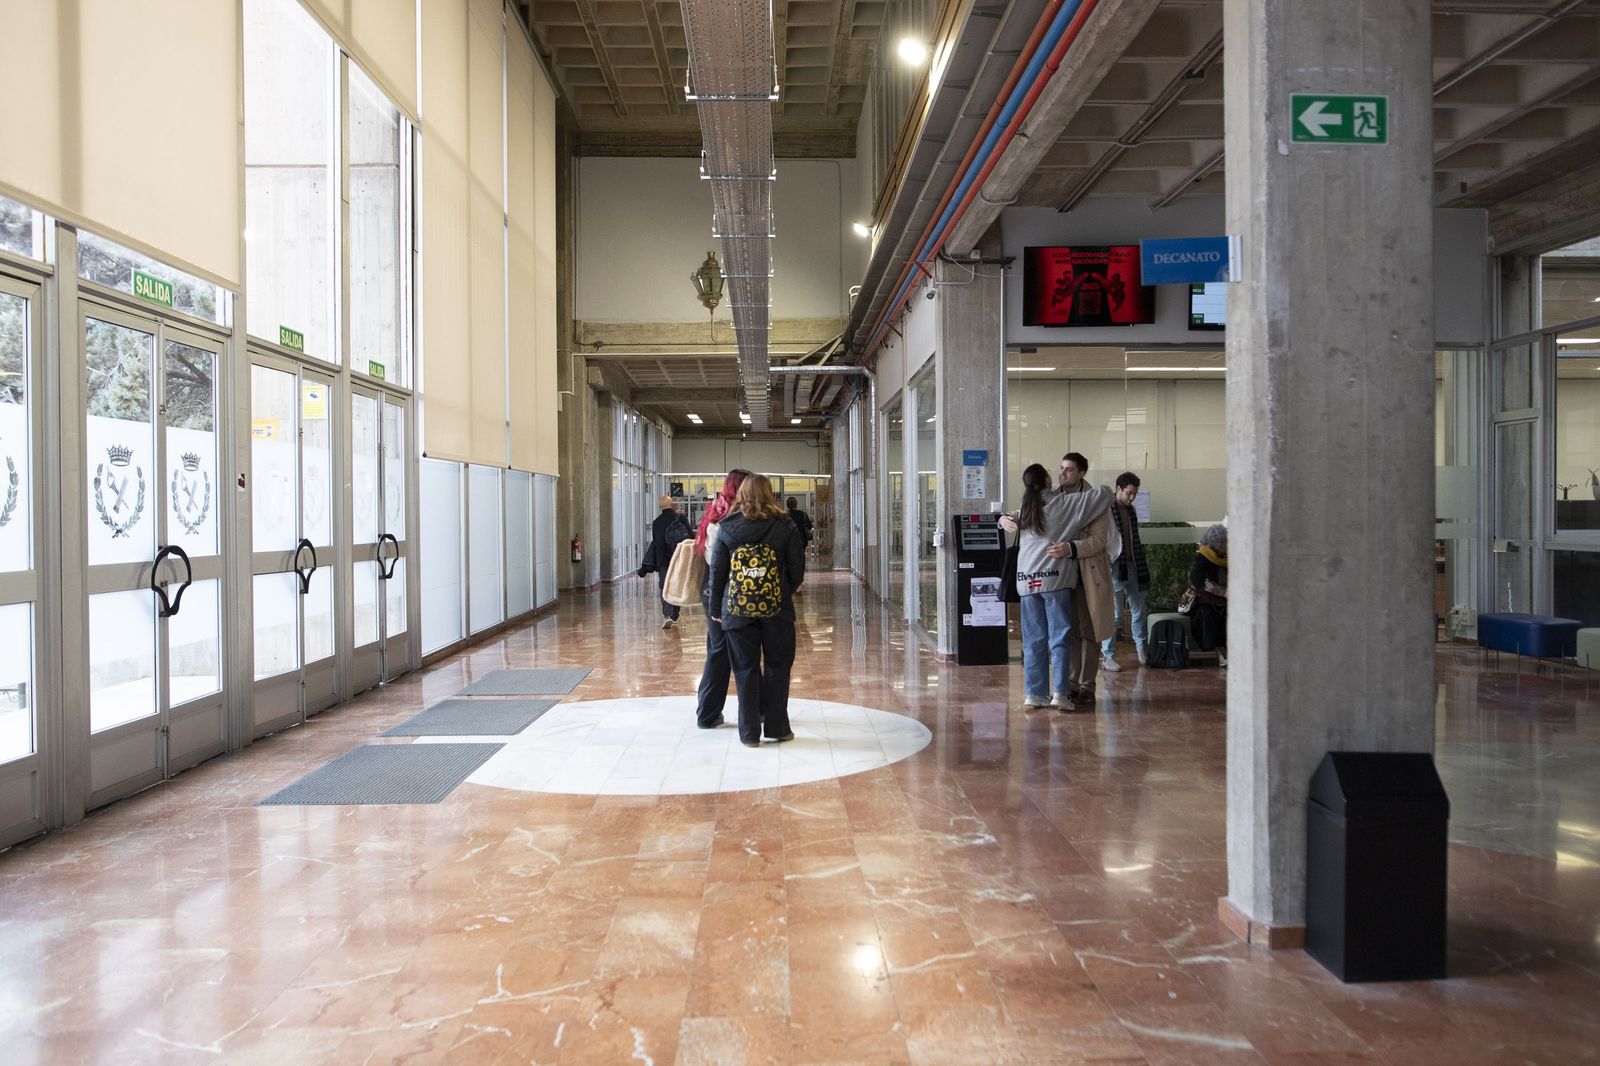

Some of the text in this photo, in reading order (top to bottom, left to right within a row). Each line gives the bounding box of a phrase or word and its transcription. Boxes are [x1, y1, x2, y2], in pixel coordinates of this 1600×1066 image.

[1153, 251, 1220, 265] DECANATO
[135, 274, 171, 304] SALIDA
[280, 329, 303, 350] SALIDA
[369, 362, 384, 378] SALIDA
